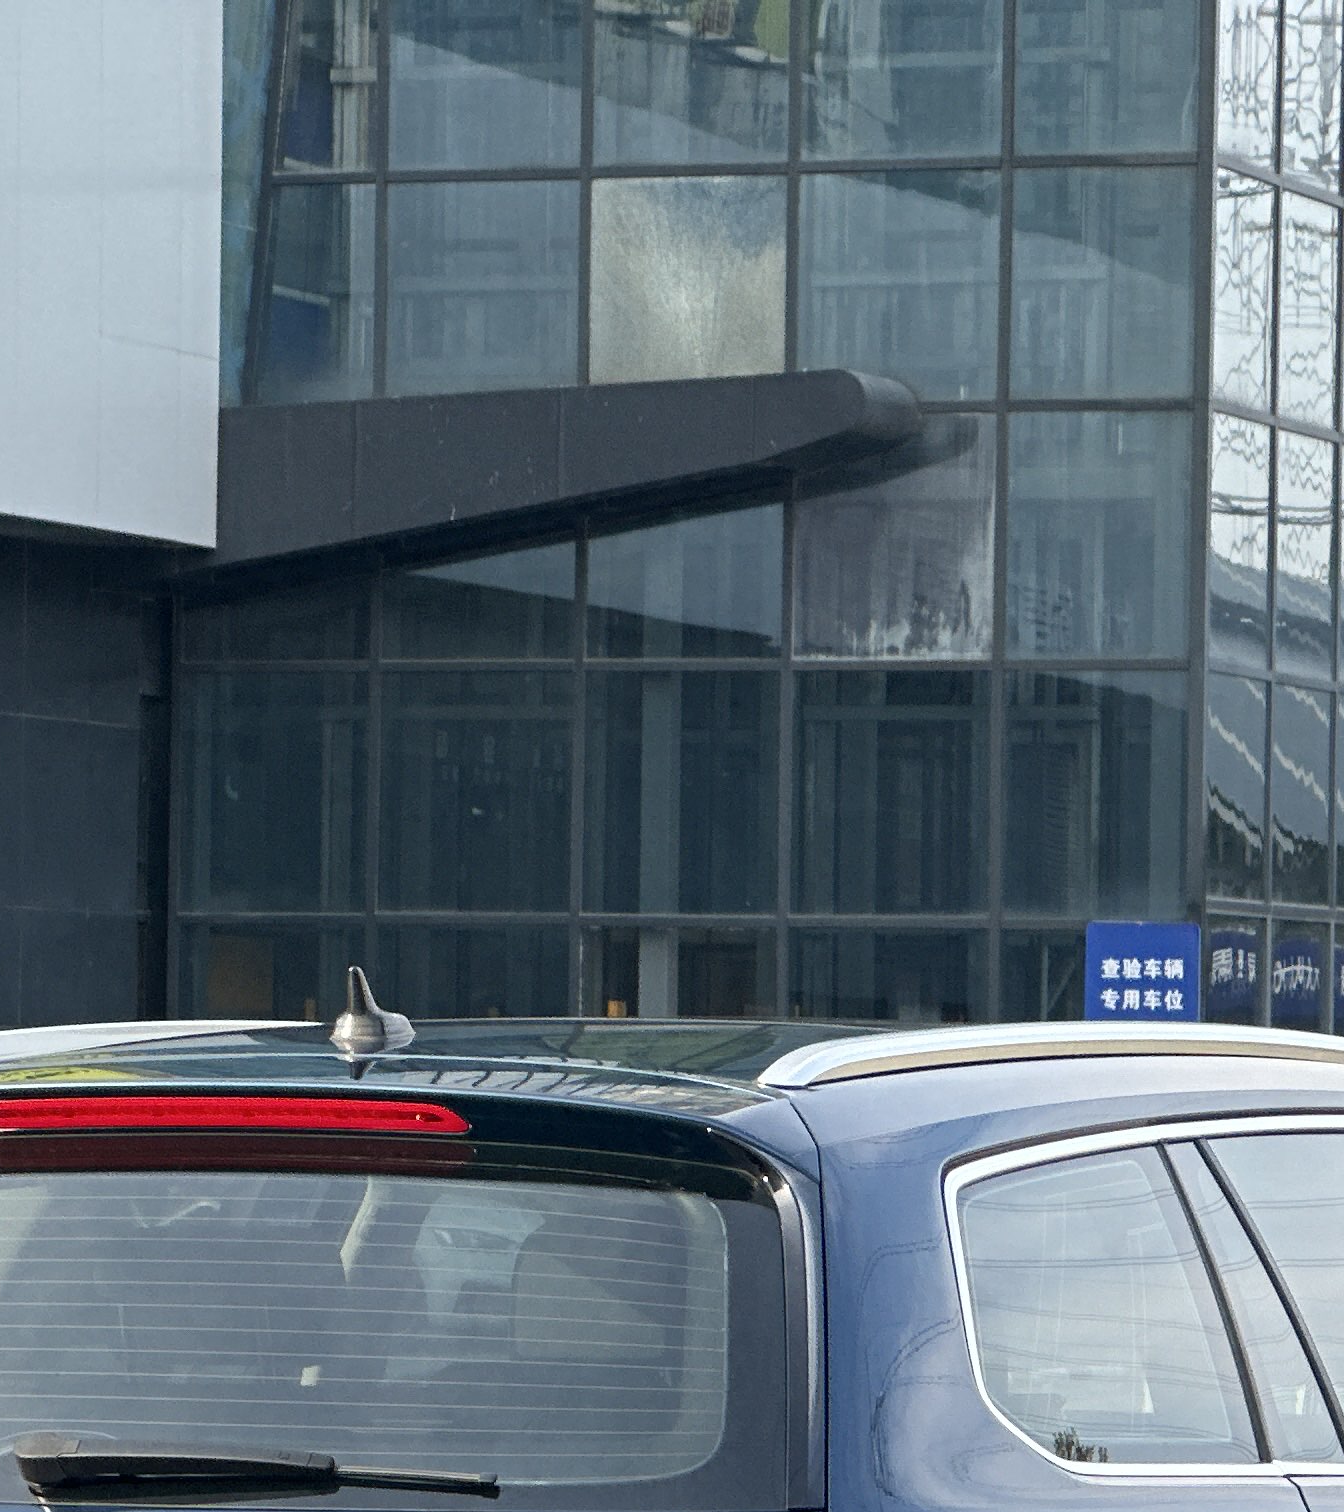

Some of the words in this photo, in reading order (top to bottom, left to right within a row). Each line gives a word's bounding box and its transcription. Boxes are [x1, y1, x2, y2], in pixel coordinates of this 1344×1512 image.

[1101, 957, 1185, 980] 查验车辆
[1101, 988, 1185, 1011] 专用车位
